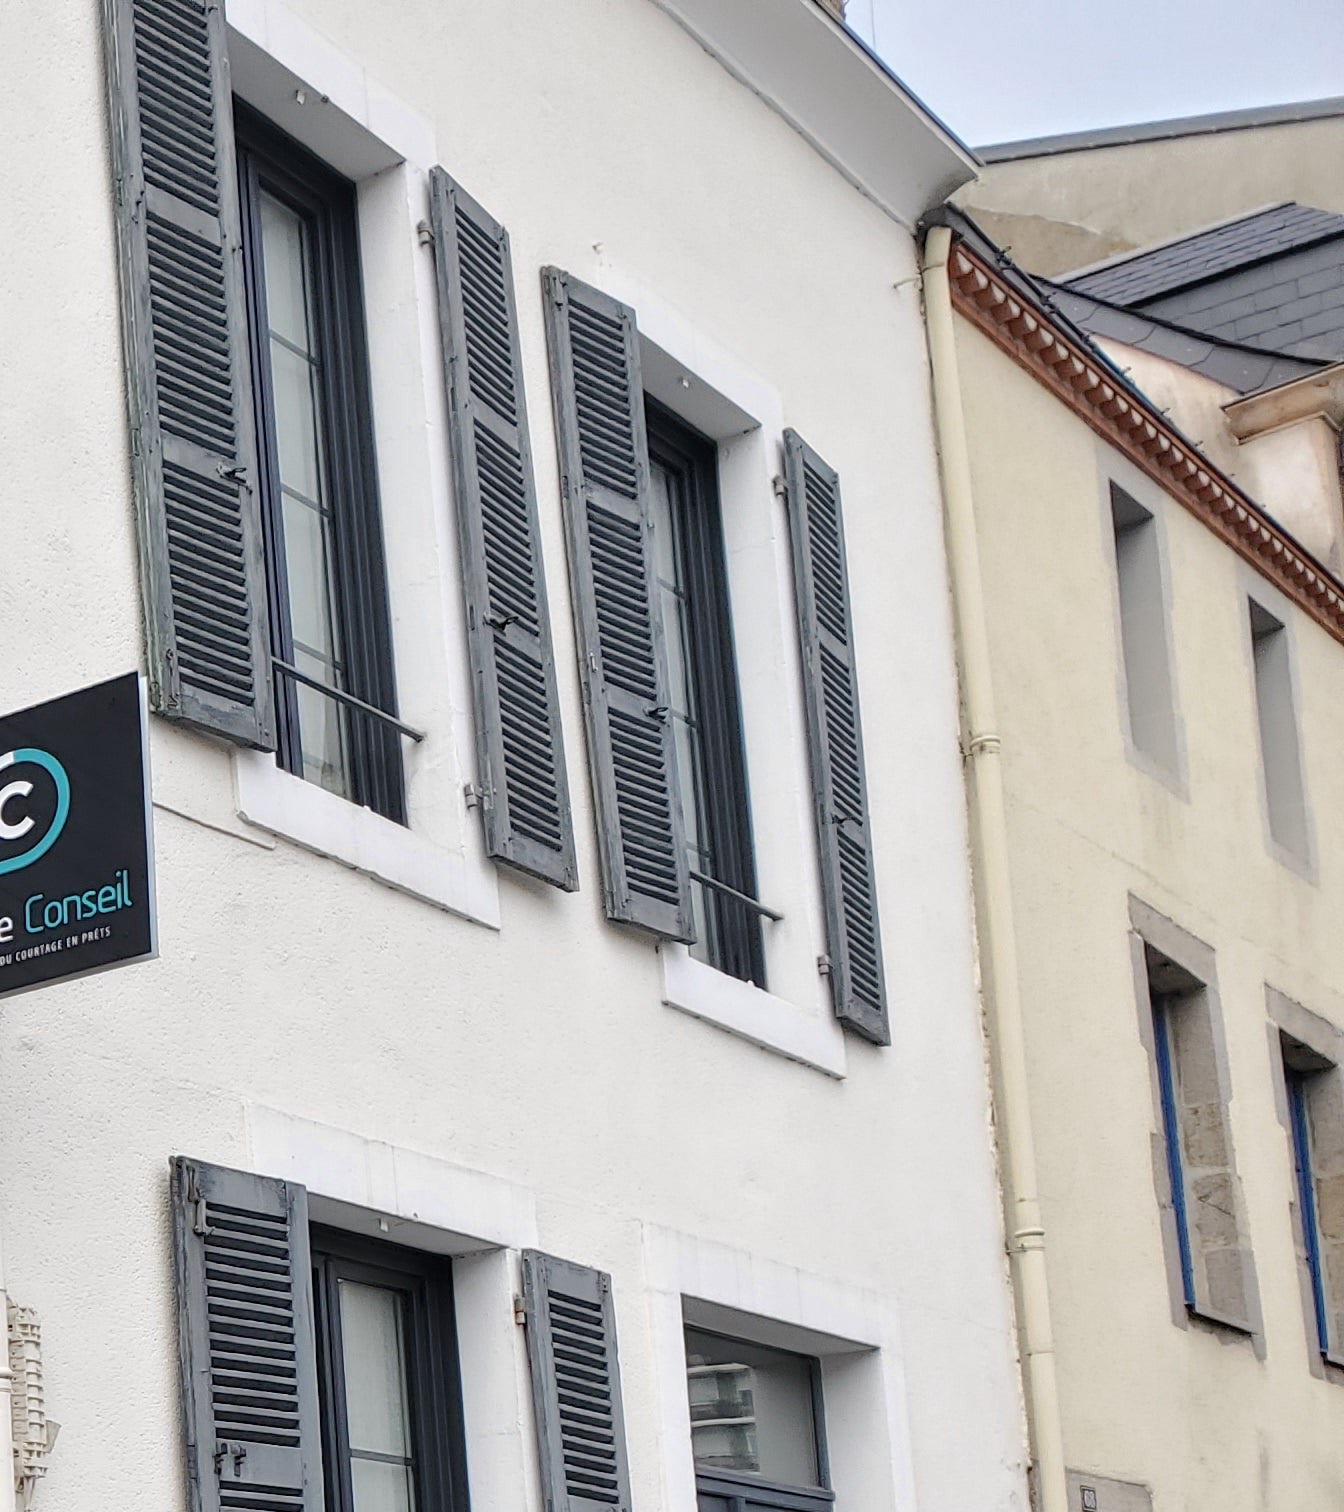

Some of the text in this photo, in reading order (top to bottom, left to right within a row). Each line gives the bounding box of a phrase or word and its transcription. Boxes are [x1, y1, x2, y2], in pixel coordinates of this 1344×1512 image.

[24, 869, 133, 934] Conseil
[0, 953, 13, 967] DU
[15, 939, 63, 962] COURTAGE
[66, 934, 79, 948] EN
[81, 925, 112, 944] PRÊTS
